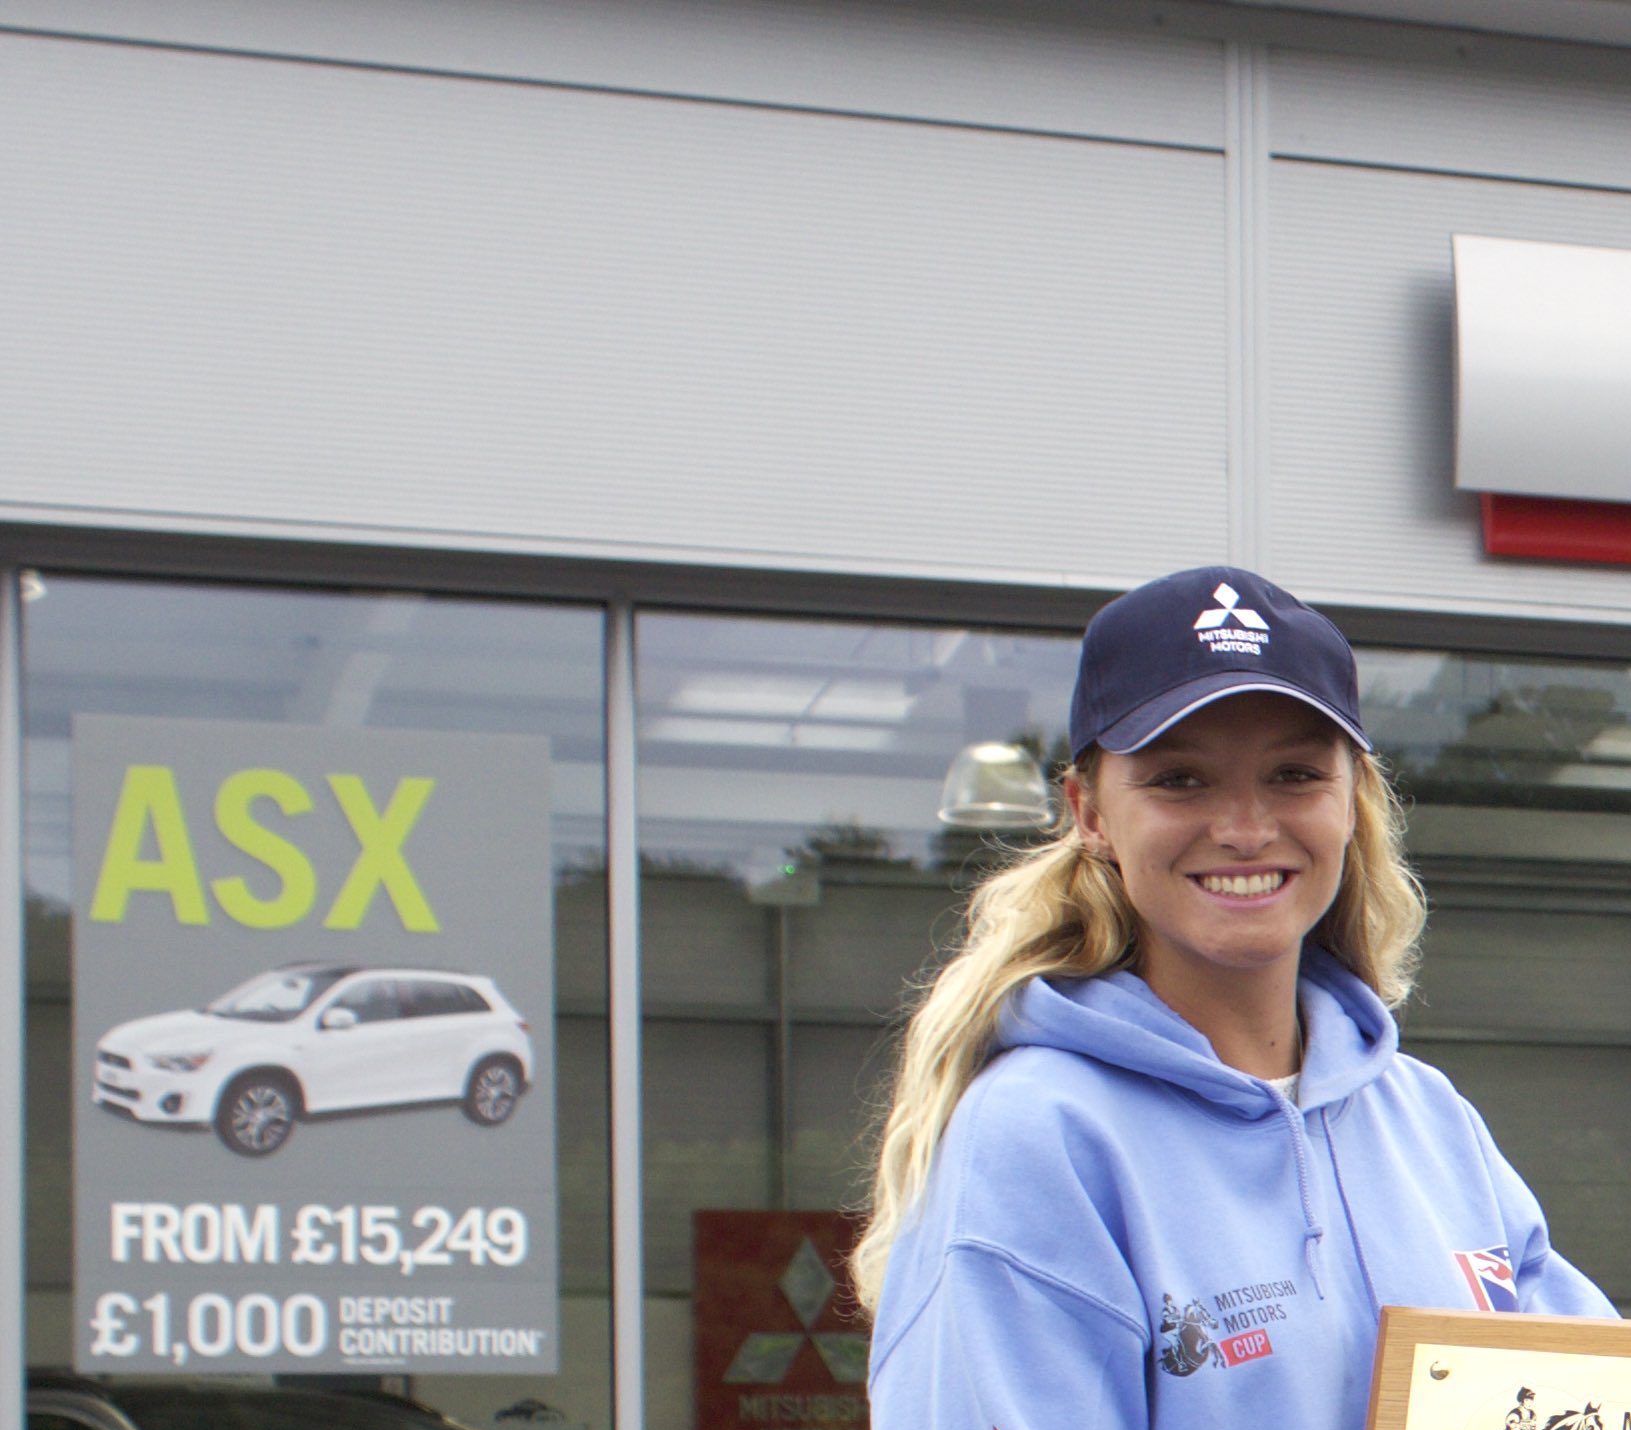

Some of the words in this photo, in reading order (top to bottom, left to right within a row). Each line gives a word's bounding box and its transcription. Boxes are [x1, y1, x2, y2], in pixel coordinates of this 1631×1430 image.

[1199, 629, 1269, 644] MITSUBISHI
[1211, 642, 1260, 655] MOTORS
[88, 765, 442, 934] ASX
[110, 1202, 280, 1264] FROM
[291, 1203, 528, 1276] £15,249
[339, 1297, 454, 1325] DEPOSIT
[1214, 1280, 1297, 1312] MITSUBISHI
[90, 1291, 328, 1366] £1,000
[1223, 1303, 1288, 1335] MOTORS
[1231, 1333, 1266, 1359] CUP
